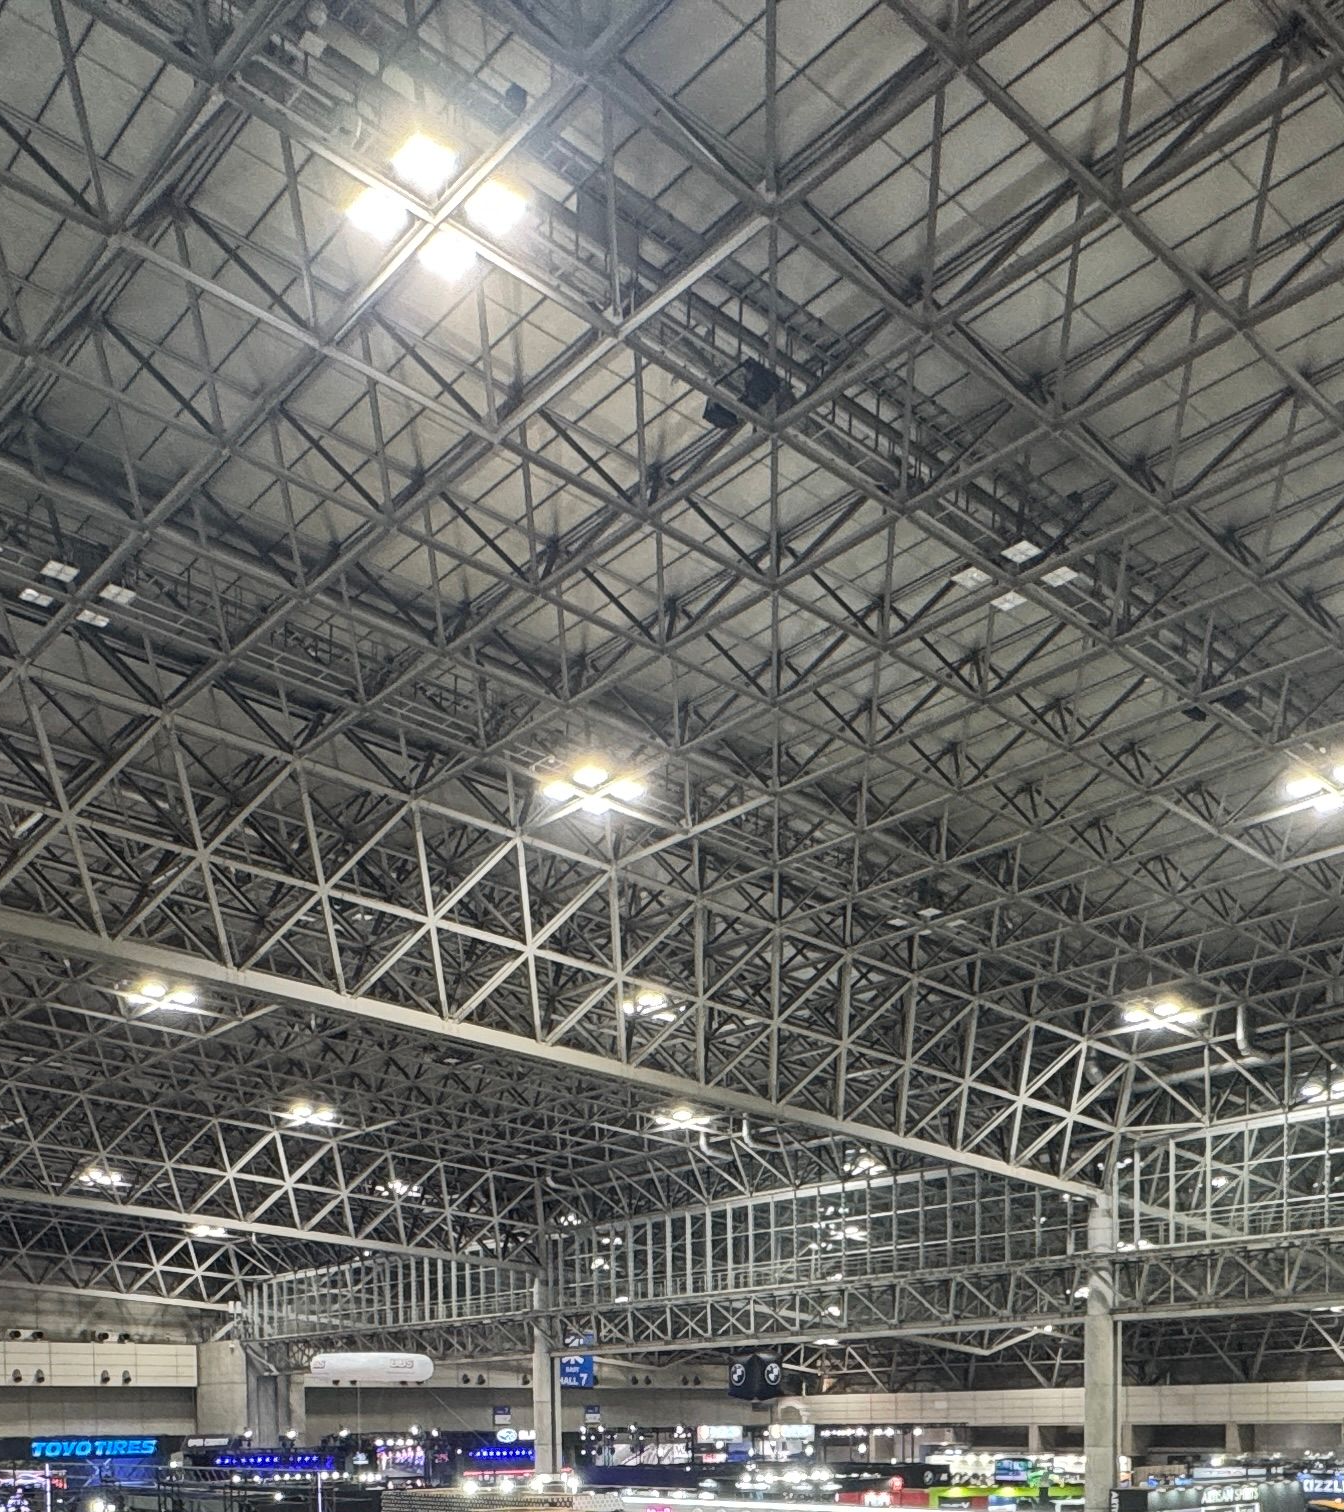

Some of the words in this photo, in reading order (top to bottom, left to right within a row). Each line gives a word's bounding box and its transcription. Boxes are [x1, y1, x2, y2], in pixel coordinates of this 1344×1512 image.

[580, 1373, 588, 1386] 7
[32, 1441, 92, 1457] TOYO
[94, 1440, 157, 1456] TIRES
